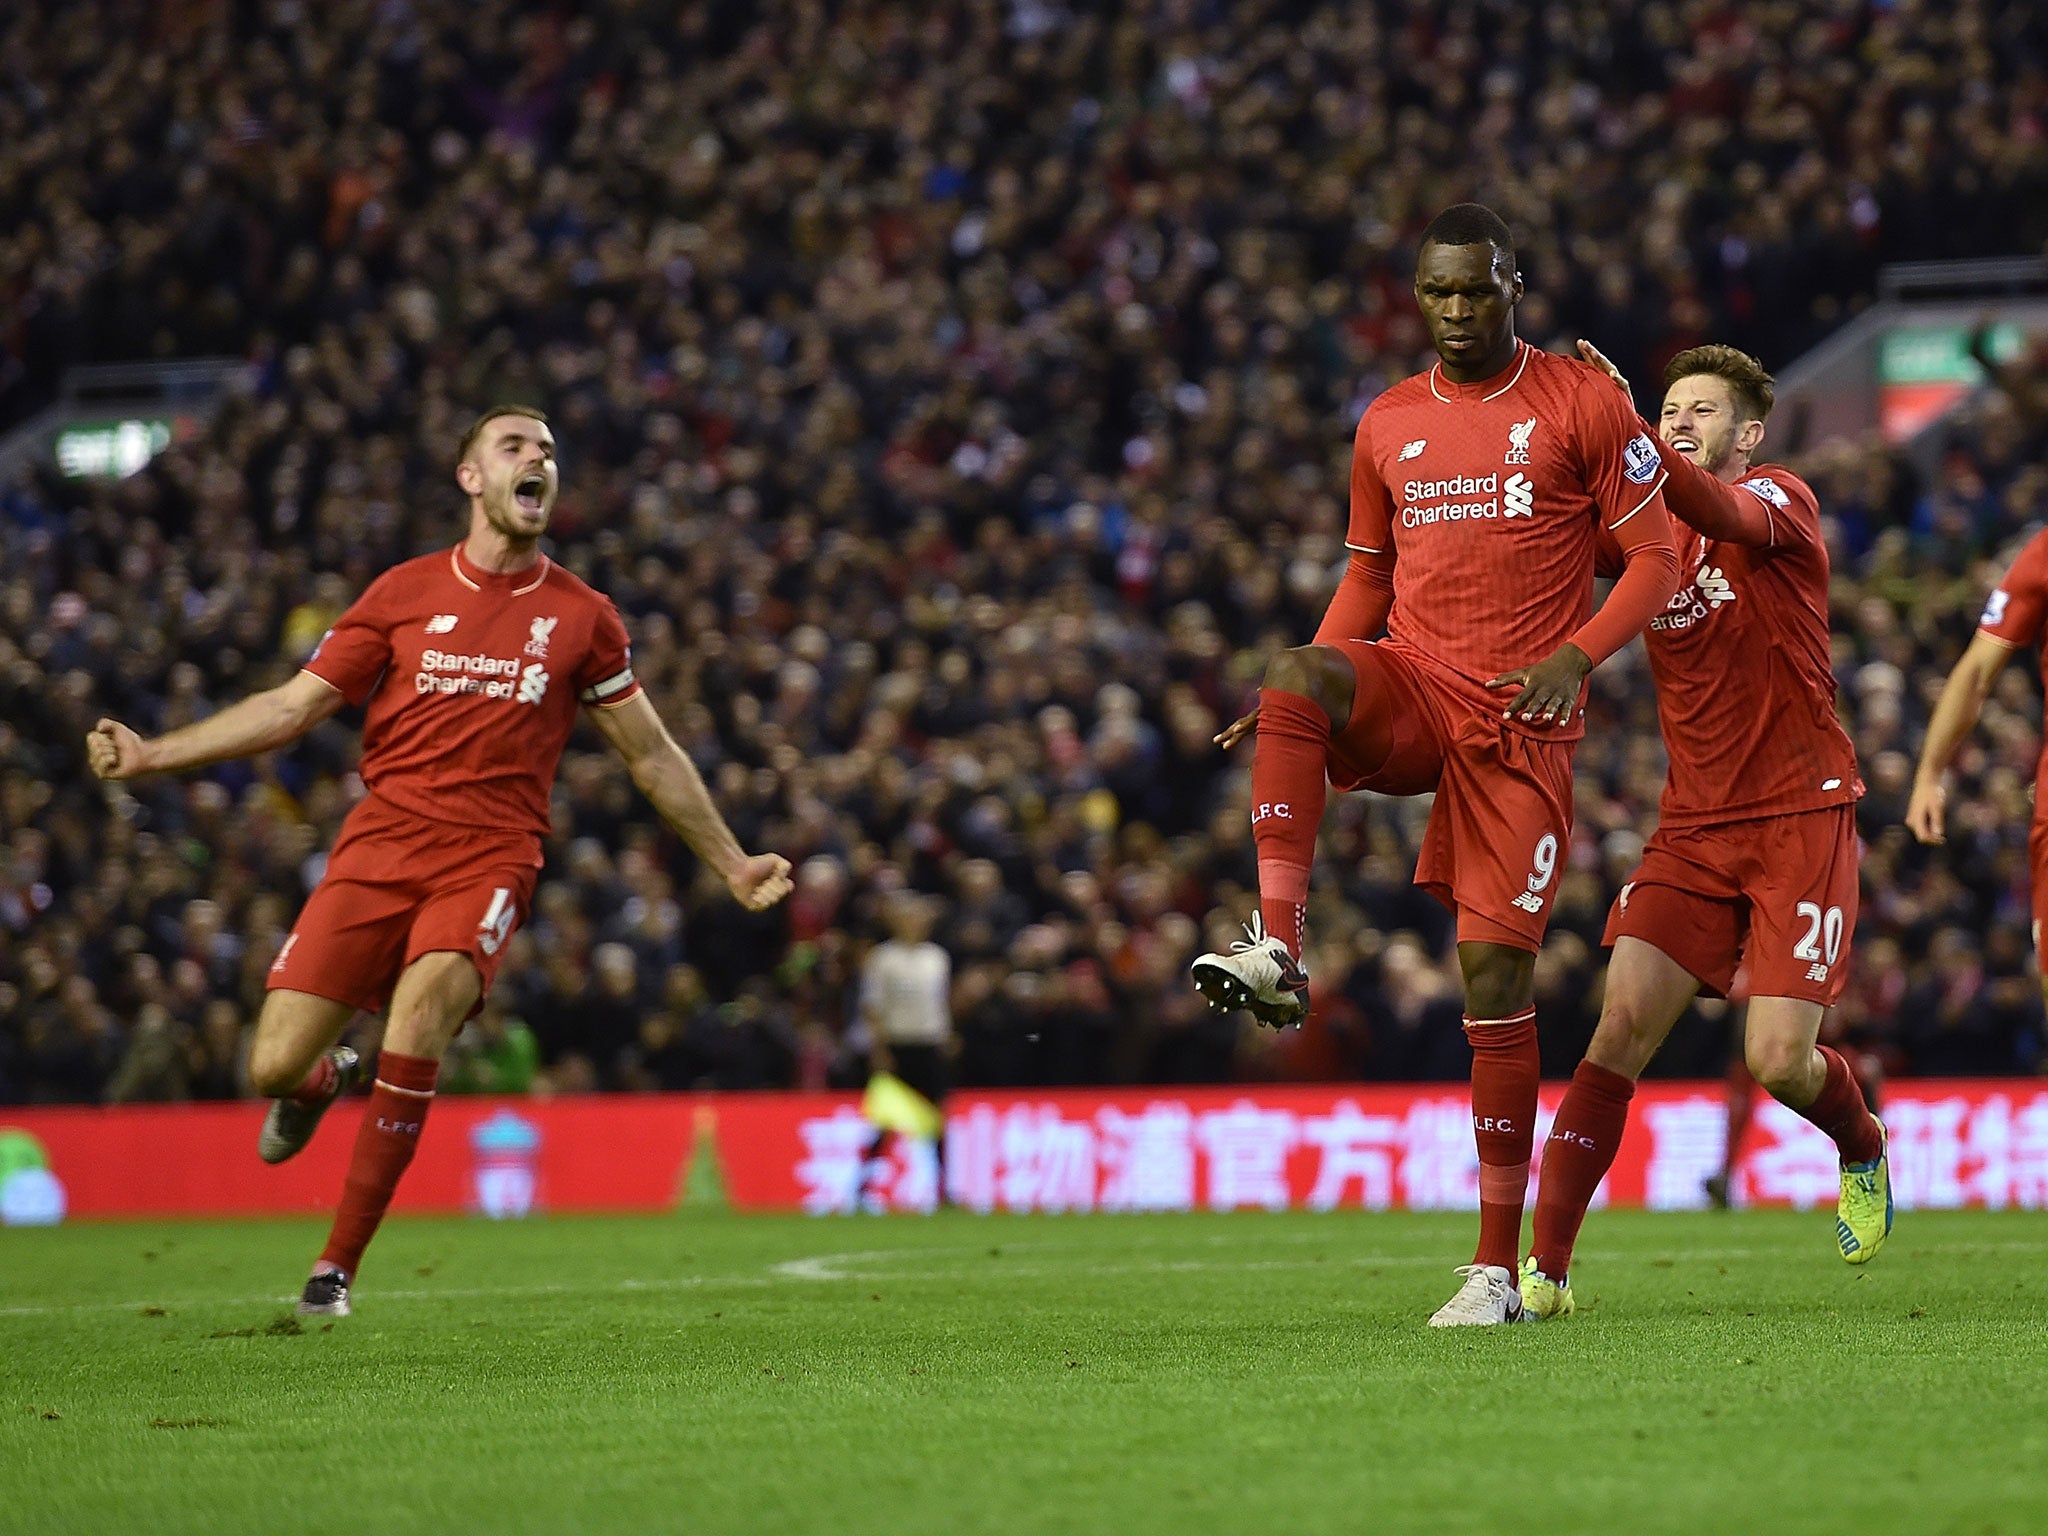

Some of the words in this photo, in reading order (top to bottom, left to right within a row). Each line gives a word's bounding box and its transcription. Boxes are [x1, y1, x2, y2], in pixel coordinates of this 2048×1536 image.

[1404, 472, 1497, 502] Standard
[1401, 498, 1497, 529] Chartered
[421, 649, 520, 678] Standard
[415, 672, 516, 700] Chartered
[1528, 832, 1558, 892] 9
[1793, 900, 1843, 967] 20
